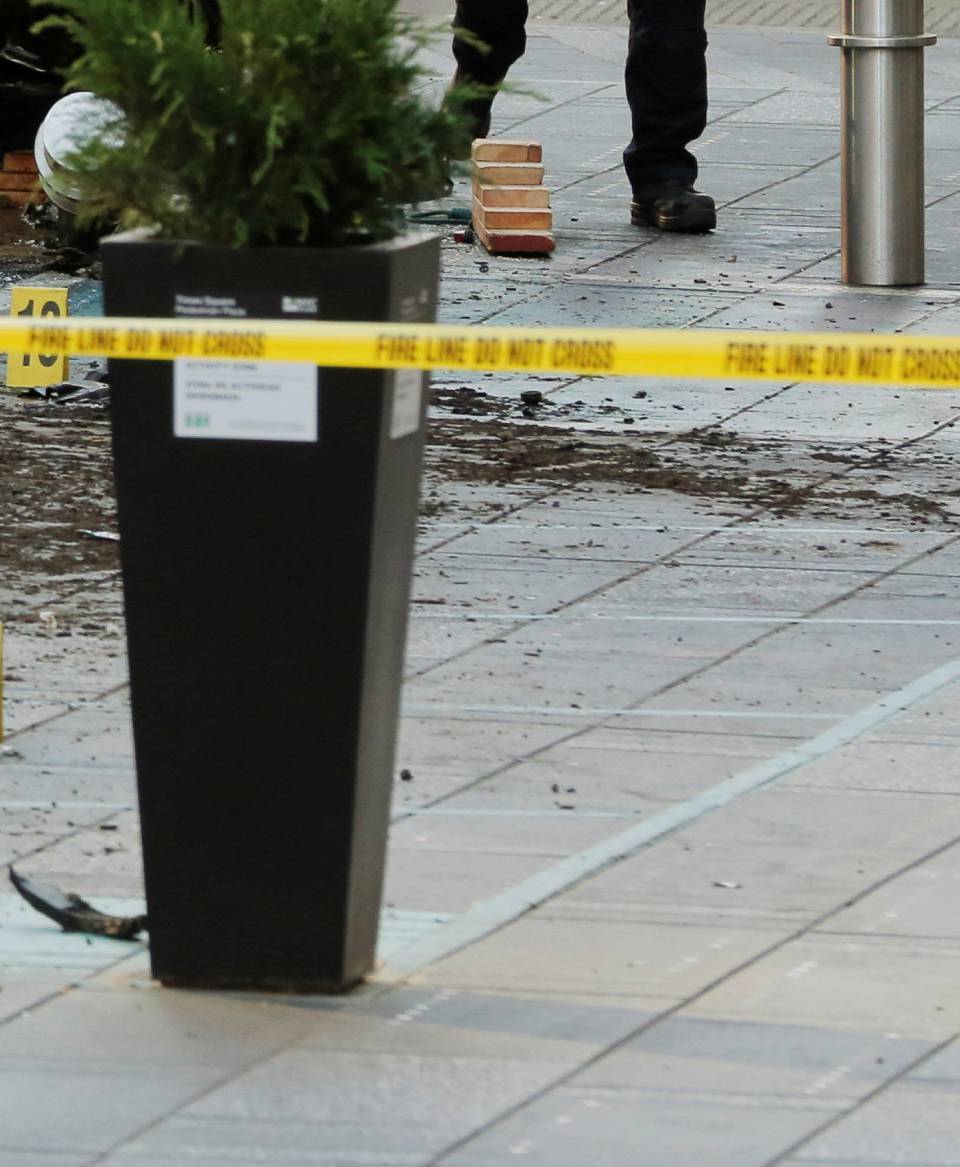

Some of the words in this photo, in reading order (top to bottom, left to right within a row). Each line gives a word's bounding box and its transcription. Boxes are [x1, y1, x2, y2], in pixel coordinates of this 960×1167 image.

[27, 325, 70, 350] FIRE
[78, 327, 117, 352] LINE
[127, 328, 147, 353] DO
[159, 328, 192, 354] NOT
[203, 329, 267, 357] CROSS
[377, 334, 418, 361] FIRE
[426, 336, 466, 363] LINE
[476, 337, 500, 365] DO
[508, 338, 543, 366] NOT
[553, 339, 615, 369] CROSS
[726, 342, 767, 373] FIRE
[775, 344, 815, 375] LINE
[824, 345, 849, 376] DO
[858, 347, 893, 378] NOT
[904, 348, 960, 381] CROSS
